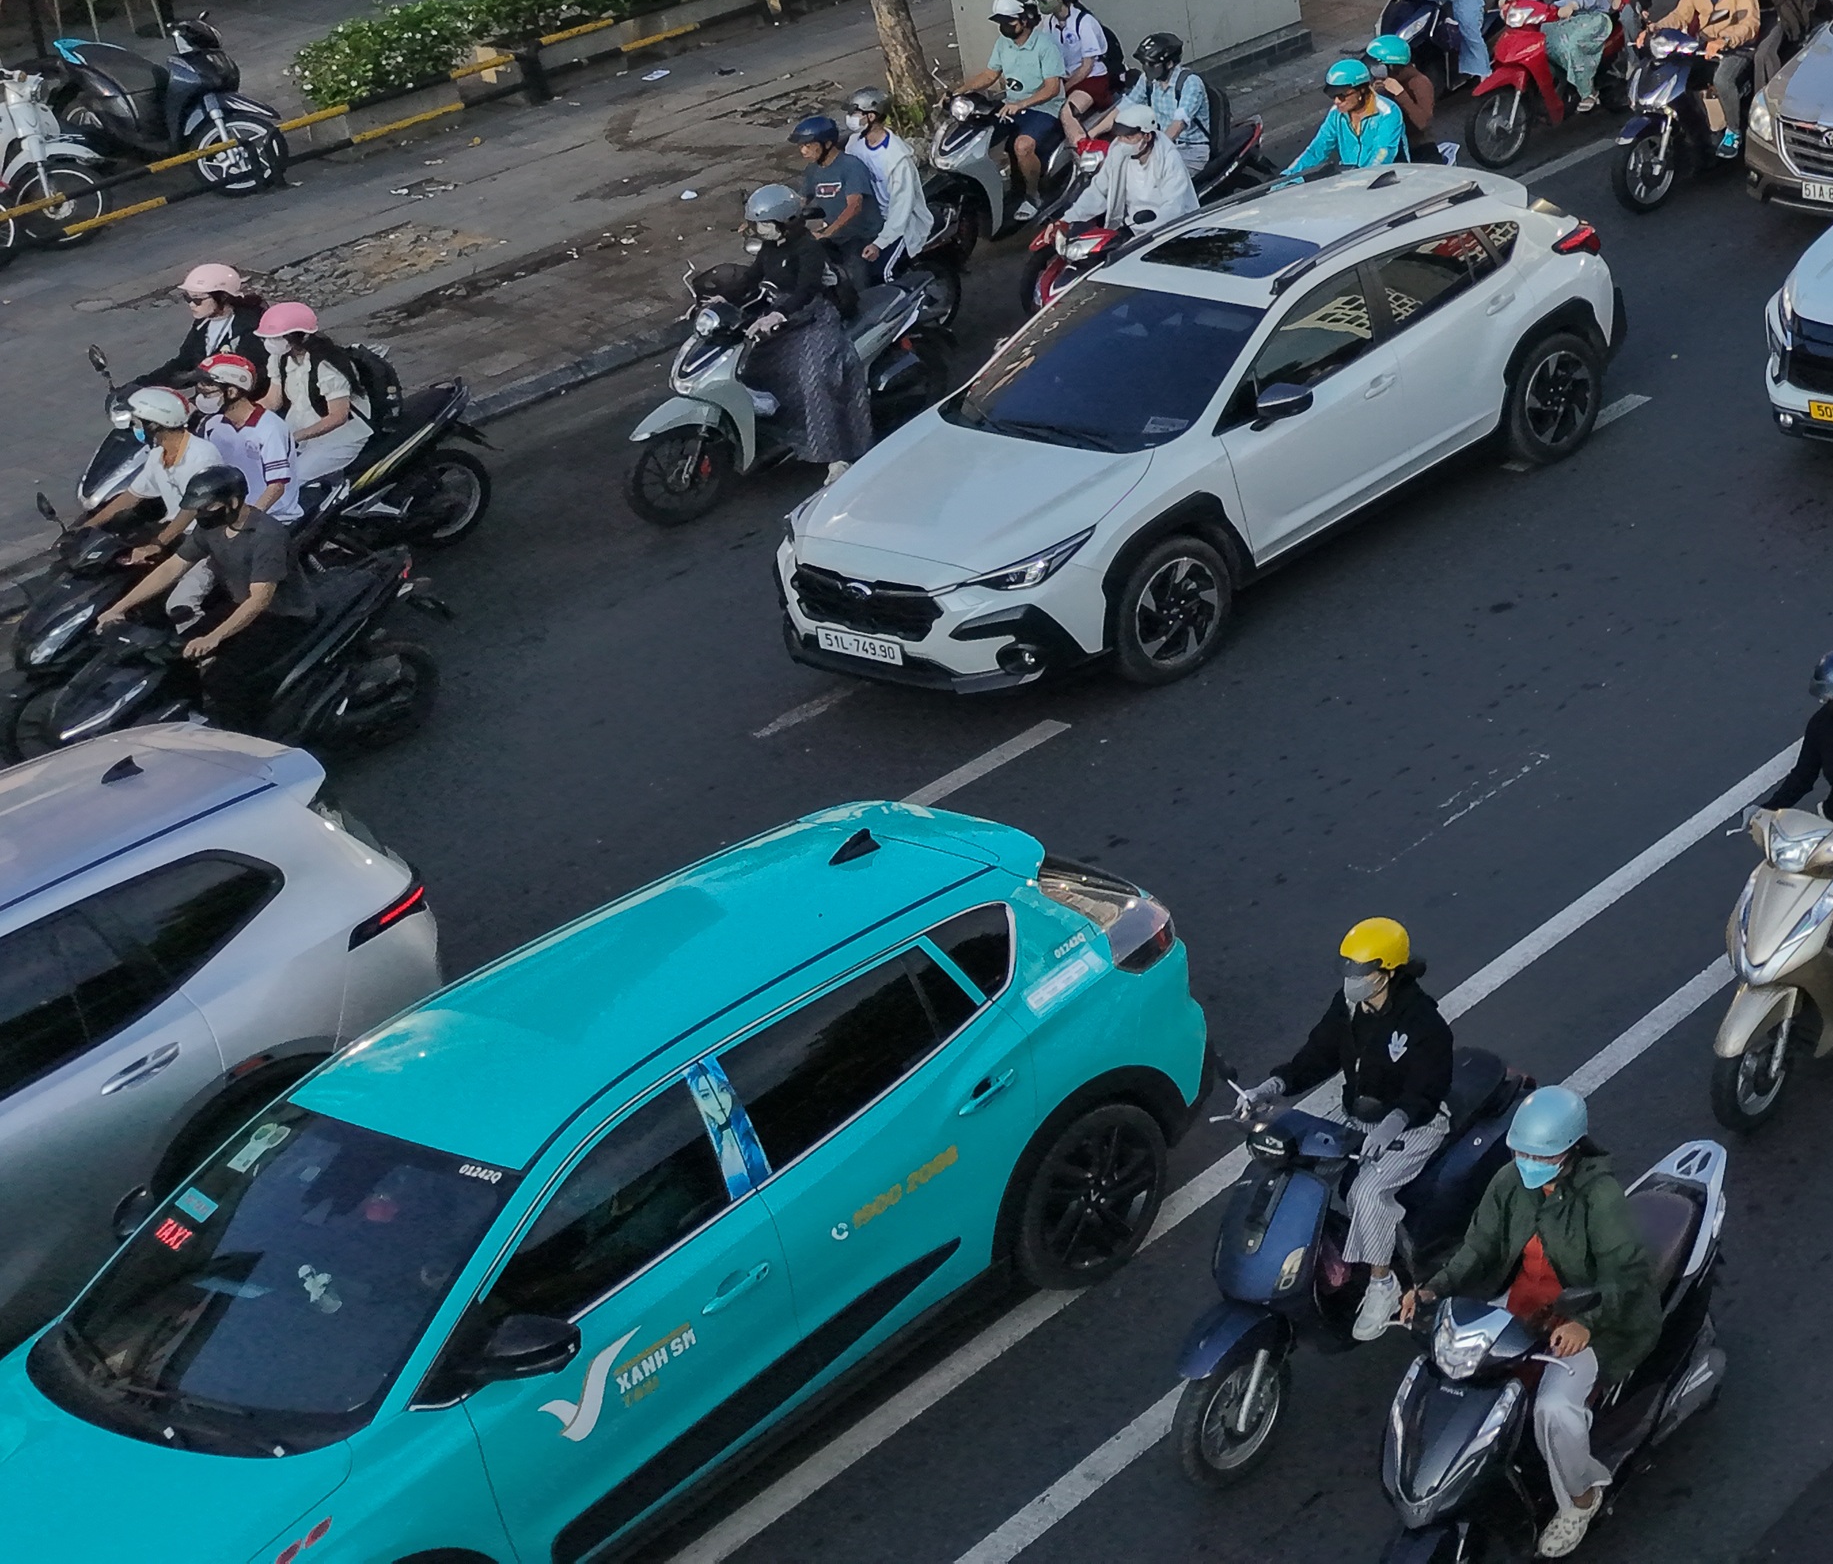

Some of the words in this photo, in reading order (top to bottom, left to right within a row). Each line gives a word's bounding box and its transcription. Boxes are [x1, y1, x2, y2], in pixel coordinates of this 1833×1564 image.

[825, 632, 896, 660] 51L-749.90
[1053, 932, 1086, 959] 01242Q
[458, 1164, 503, 1184] 01242Q
[155, 1217, 194, 1251] TAXI
[616, 1347, 669, 1395] XANH
[672, 1328, 697, 1358] SM
